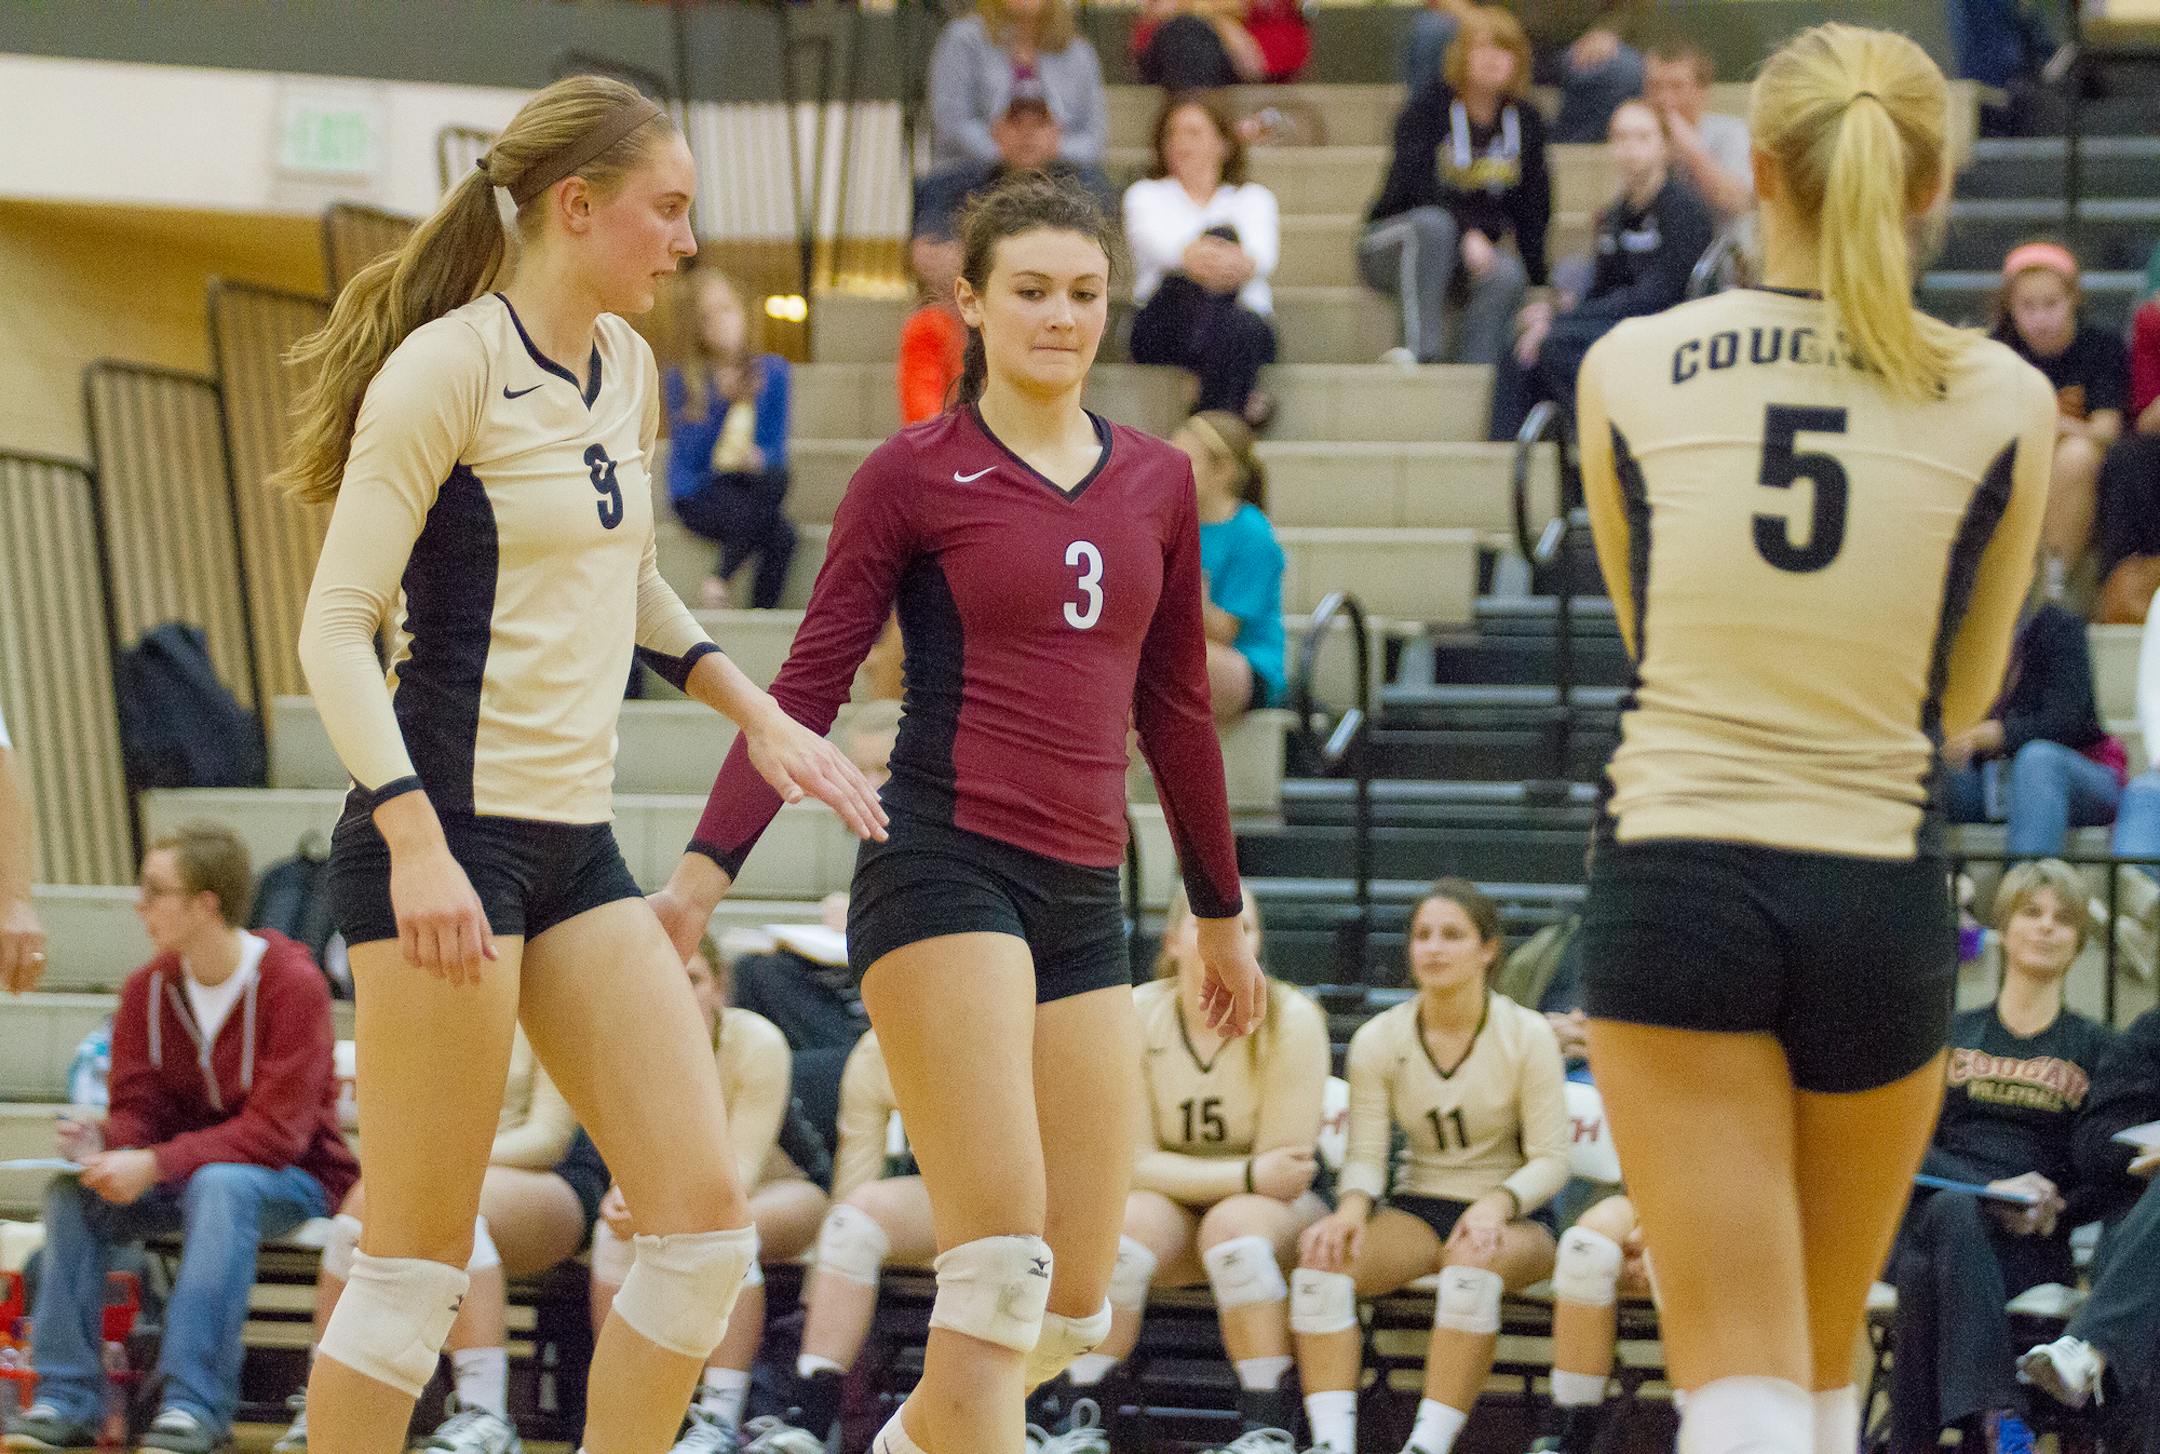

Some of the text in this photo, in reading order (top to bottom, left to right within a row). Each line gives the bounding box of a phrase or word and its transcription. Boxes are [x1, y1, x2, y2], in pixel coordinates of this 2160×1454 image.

[1671, 326, 1948, 401] COUG
[583, 442, 624, 530] 9
[1752, 402, 1849, 575] 5
[1062, 539, 1105, 630] 3
[1179, 1098, 1225, 1143] 15
[1426, 1106, 1468, 1151] 11
